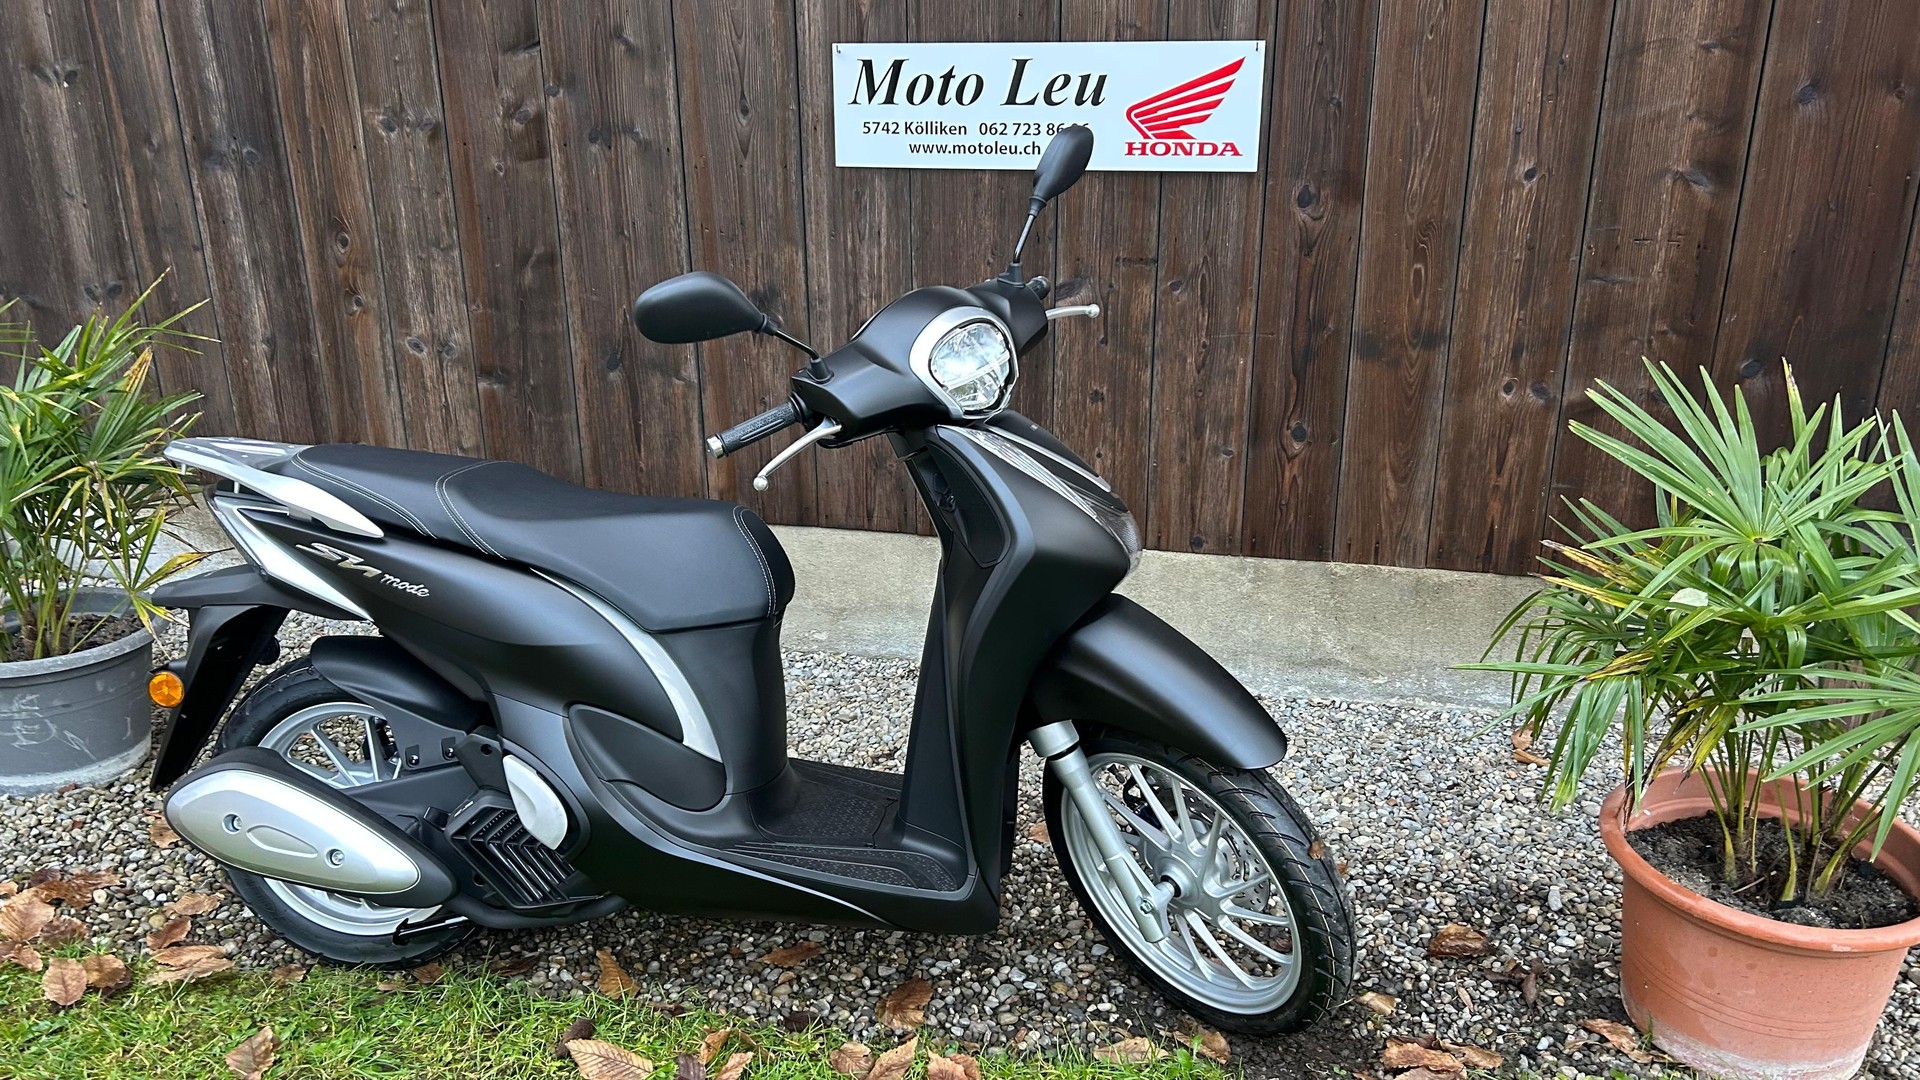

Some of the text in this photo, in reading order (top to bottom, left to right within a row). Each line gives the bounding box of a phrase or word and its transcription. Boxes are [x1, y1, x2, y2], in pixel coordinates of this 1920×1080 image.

[848, 58, 1108, 106] Moto Leu
[863, 121, 900, 135] 5742
[904, 120, 967, 136] Kölliken
[979, 122, 1008, 136] 062
[1013, 122, 1041, 136] 723
[909, 141, 1041, 156] www.motoleu.ch
[1125, 141, 1243, 157] HONDA
[379, 573, 429, 597] mode
